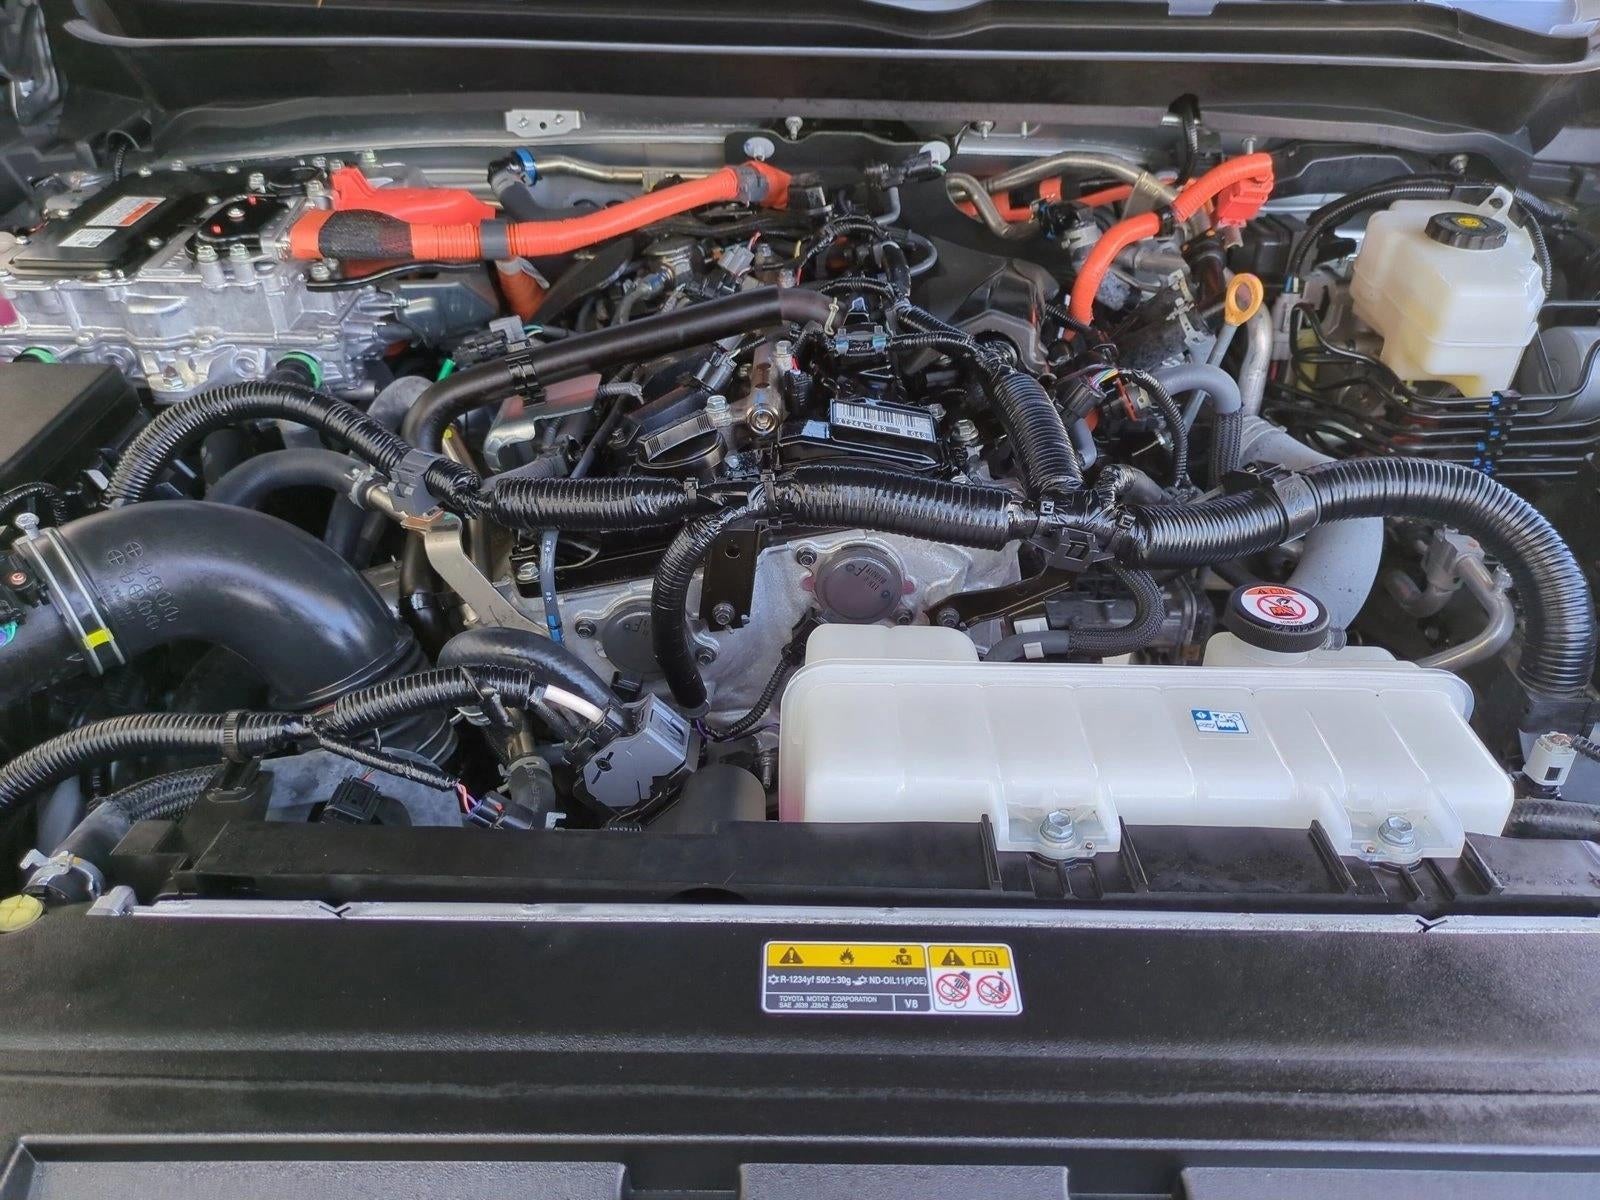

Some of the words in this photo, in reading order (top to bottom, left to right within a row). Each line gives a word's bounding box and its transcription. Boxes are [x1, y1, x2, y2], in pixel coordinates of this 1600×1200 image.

[780, 975, 815, 985] R-1234yf
[816, 975, 851, 986] 500±30g
[869, 976, 927, 986] ND-OIL11(POE)
[832, 995, 878, 1003] CORPORATION
